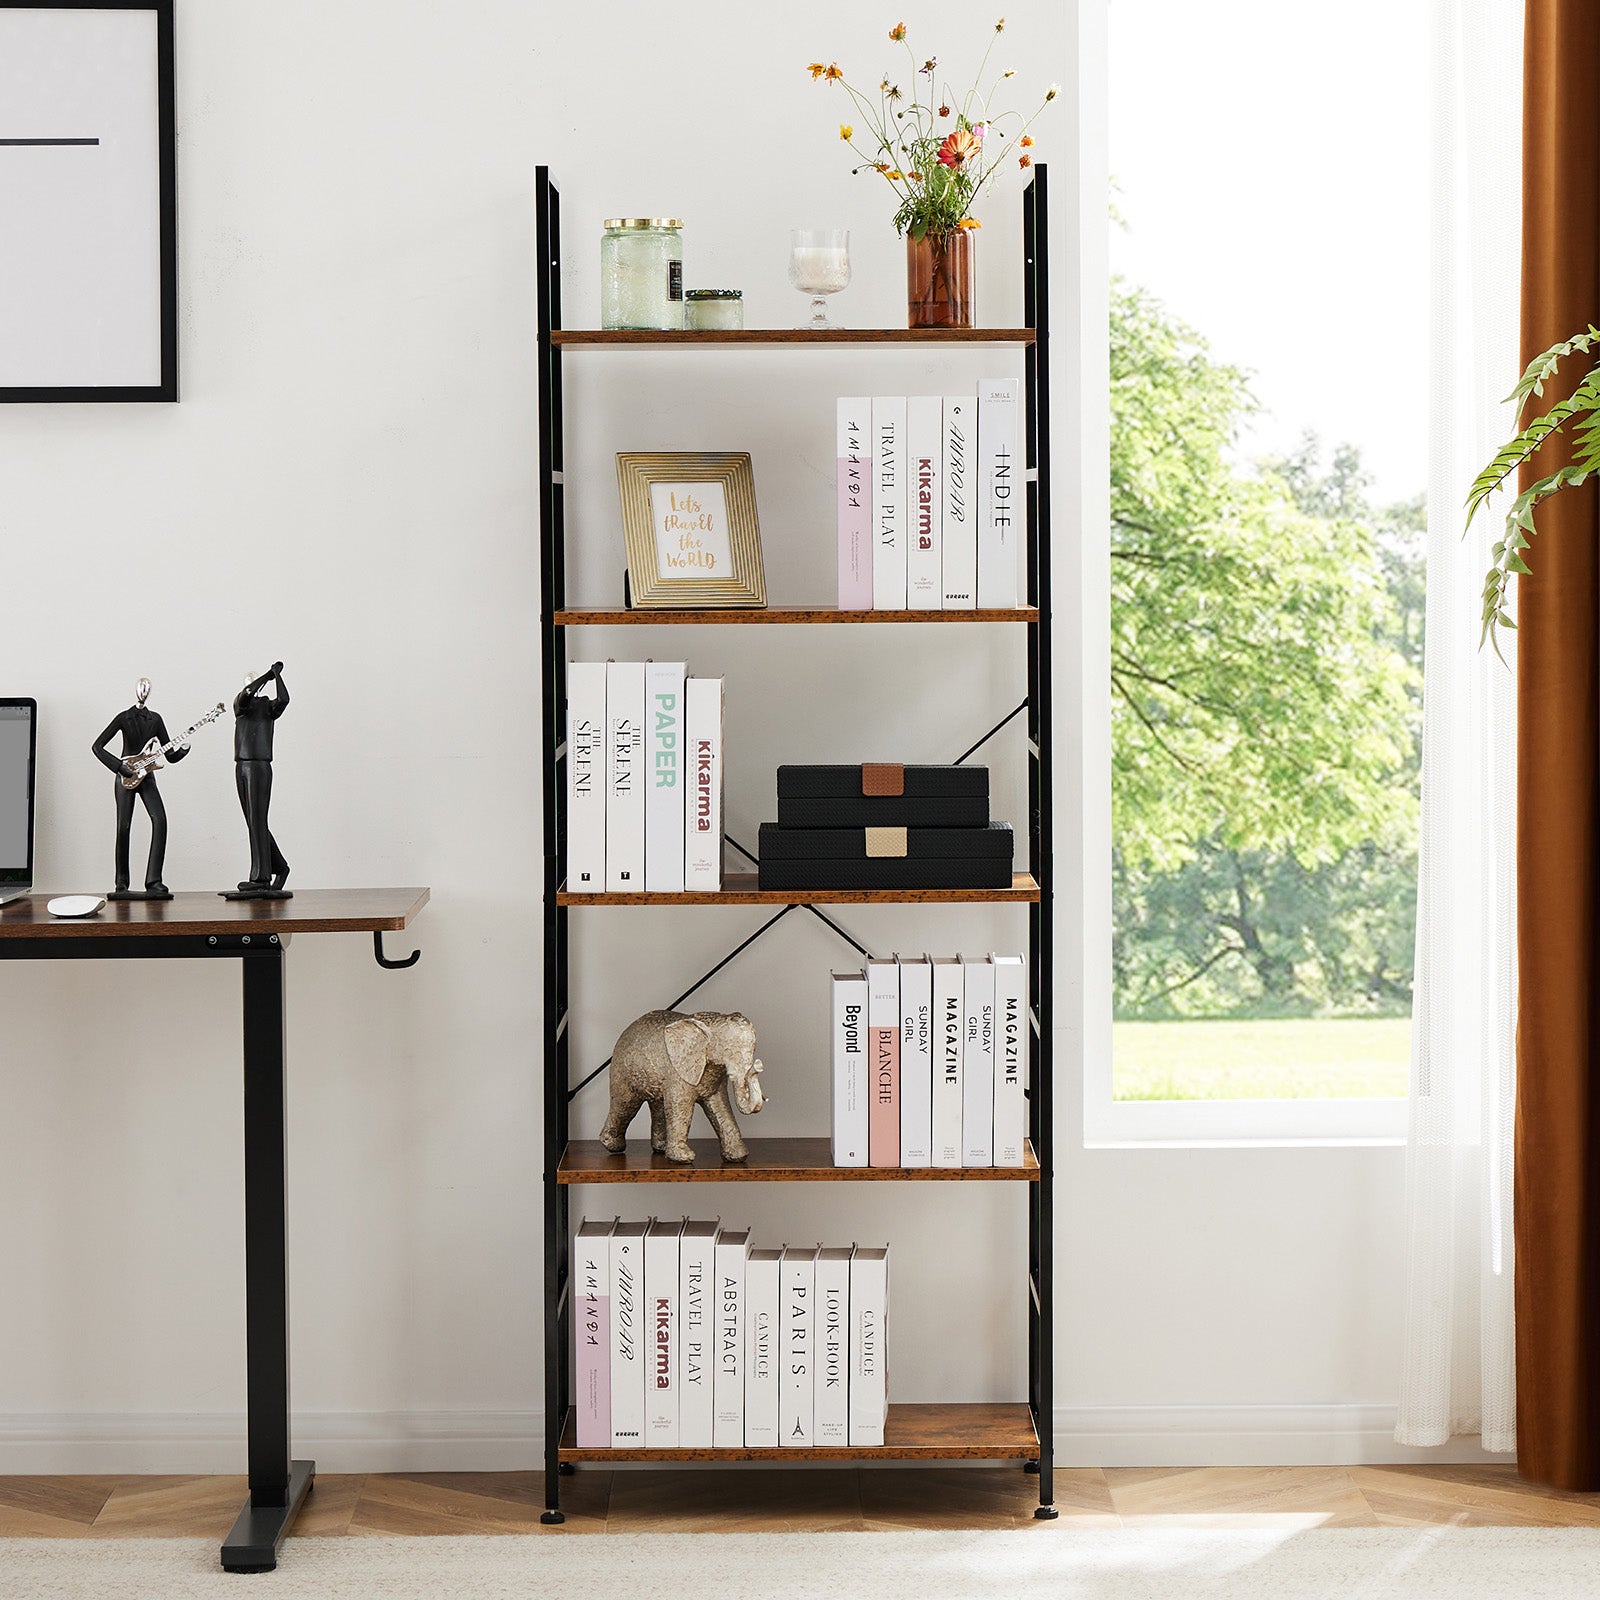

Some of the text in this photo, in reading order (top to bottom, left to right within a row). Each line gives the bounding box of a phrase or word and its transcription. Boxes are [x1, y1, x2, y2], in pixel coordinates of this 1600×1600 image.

[847, 420, 861, 509] AMANDA
[882, 423, 894, 547] TRAVEL PLAY
[995, 454, 1011, 527] INDIE
[670, 492, 702, 513] Lets
[679, 532, 703, 552] the
[575, 720, 591, 798] SERENE
[592, 727, 601, 751] THE
[615, 719, 631, 797] SERENE
[631, 725, 641, 751] THE
[655, 694, 676, 787] PAPER
[842, 1006, 861, 1053] Beyond
[905, 1017, 913, 1042] GIRL
[919, 1006, 927, 1053] SUNDAY
[946, 998, 957, 1084] MAGAZINE
[969, 1017, 977, 1042] GIRL
[982, 1006, 991, 1053] SUNDAY
[1006, 999, 1017, 1084] MAGAZINE
[879, 1031, 891, 1104] BLANCHE
[585, 1260, 599, 1346] AMANDA
[689, 1262, 702, 1385] TRAVEL PLAY
[723, 1278, 737, 1376] ABSTRACT
[827, 1290, 839, 1387] LOOK-BOOK
[758, 1312, 769, 1378] CANDICE
[862, 1310, 875, 1376] CANDICE
